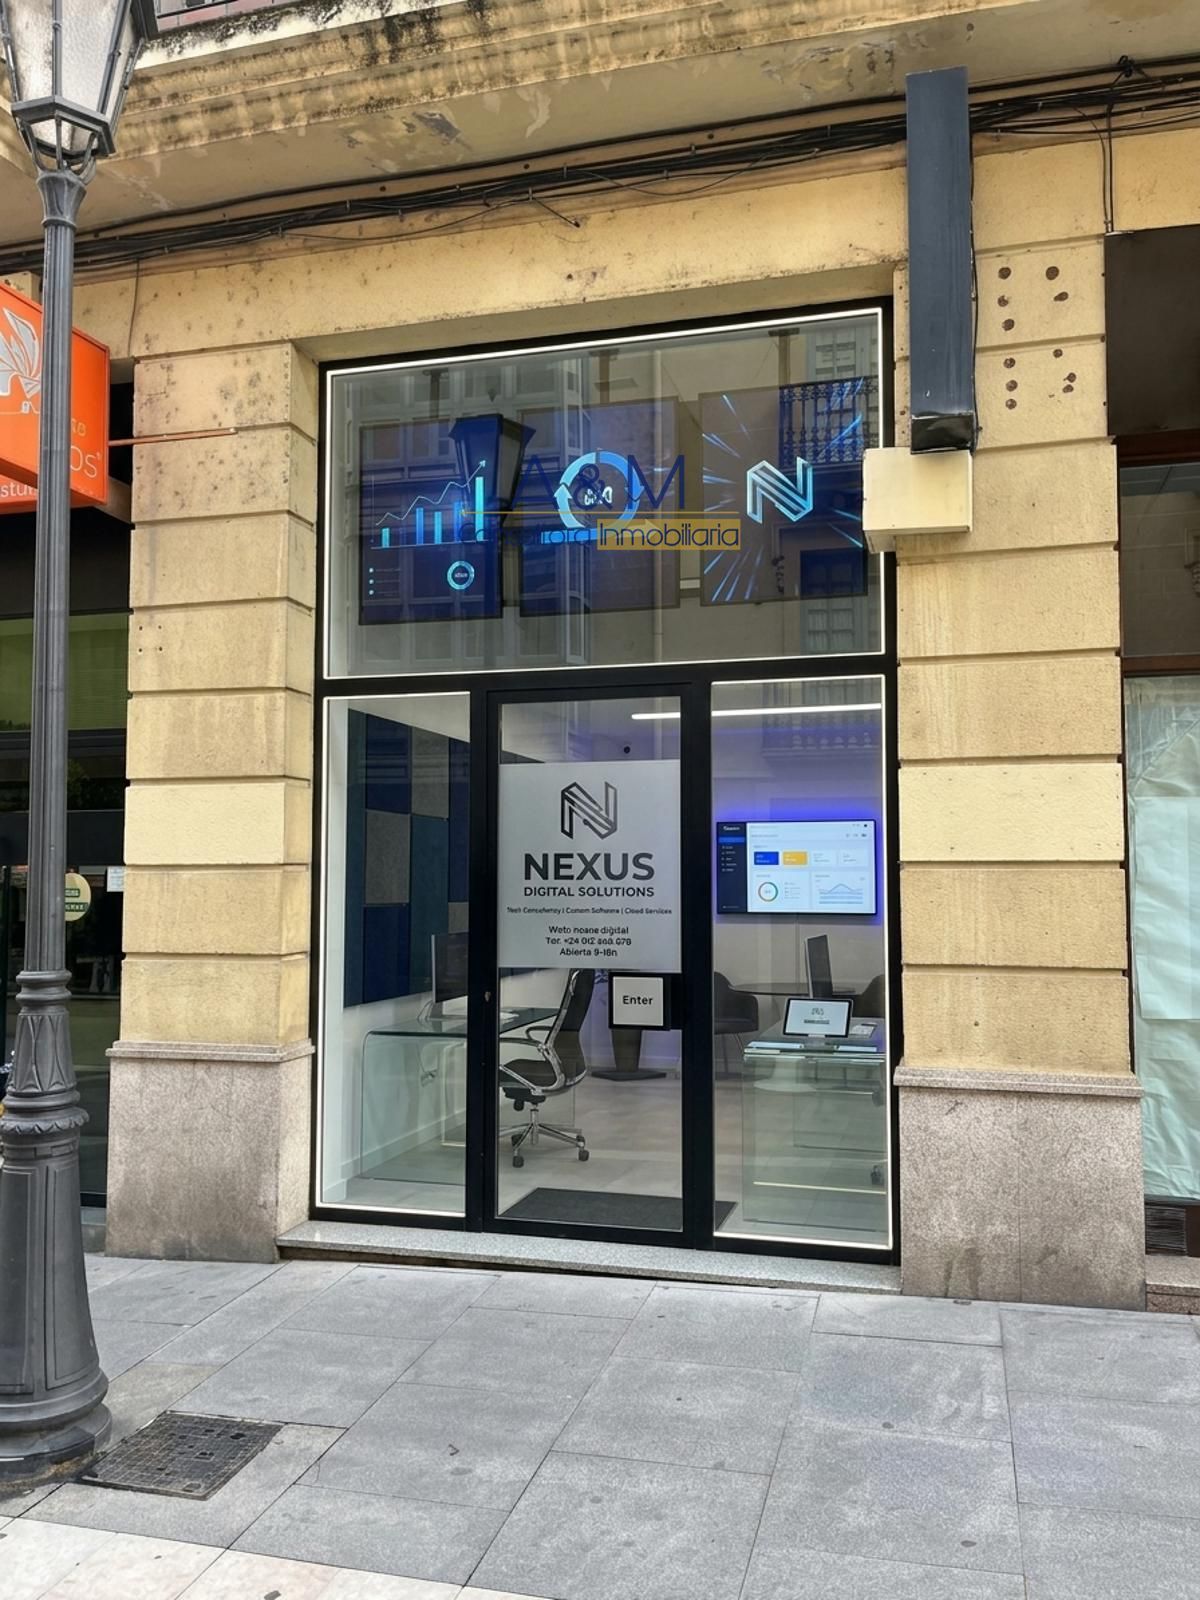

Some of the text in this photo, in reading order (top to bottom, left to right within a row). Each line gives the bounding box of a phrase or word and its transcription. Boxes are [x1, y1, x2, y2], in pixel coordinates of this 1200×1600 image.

[524, 852, 655, 881] NEXUS
[523, 886, 655, 898] DIGITAL SOLUTIONS
[622, 994, 654, 1005] Enter
